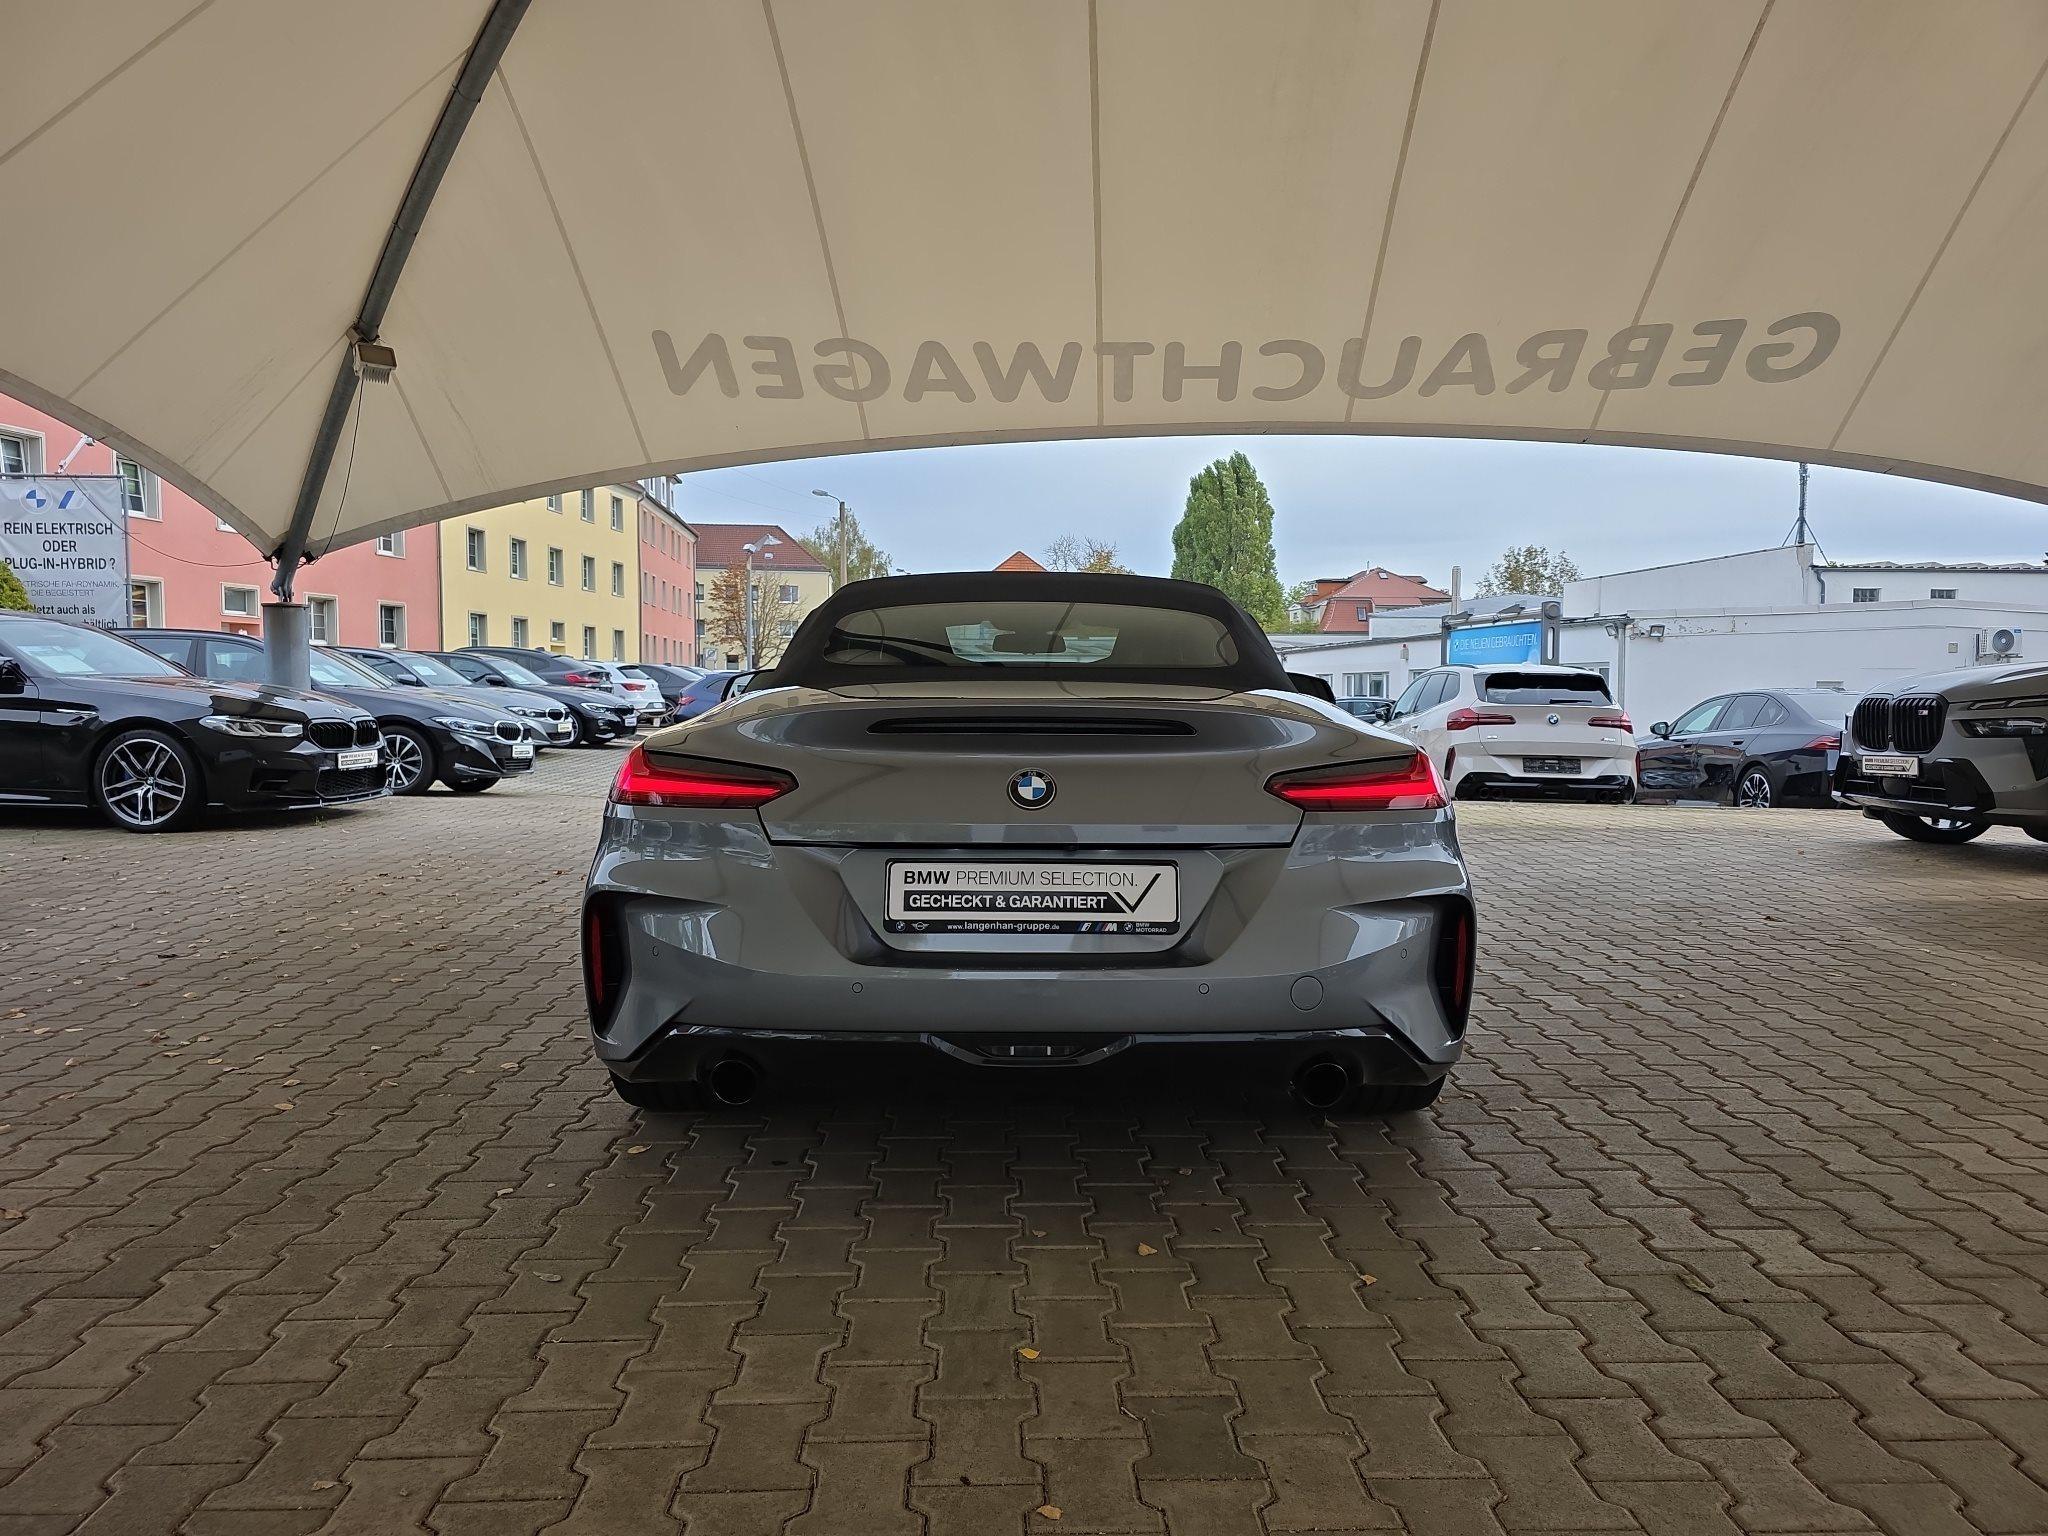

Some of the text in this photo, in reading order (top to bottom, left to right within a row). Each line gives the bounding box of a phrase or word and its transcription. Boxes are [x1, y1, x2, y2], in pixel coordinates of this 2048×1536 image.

[4, 522, 113, 535] REIN ELEKTRISCH
[42, 540, 77, 552] ODER
[109, 558, 116, 570] ?
[57, 604, 80, 614] auch
[82, 604, 96, 615] als
[82, 619, 118, 629] hältlich
[904, 870, 1138, 887] BMW PREMIUM SELECTION.
[909, 894, 1108, 909] GECHECKT & GARANTIERT
[947, 921, 1060, 932] www.langenhan-gruppe.de
